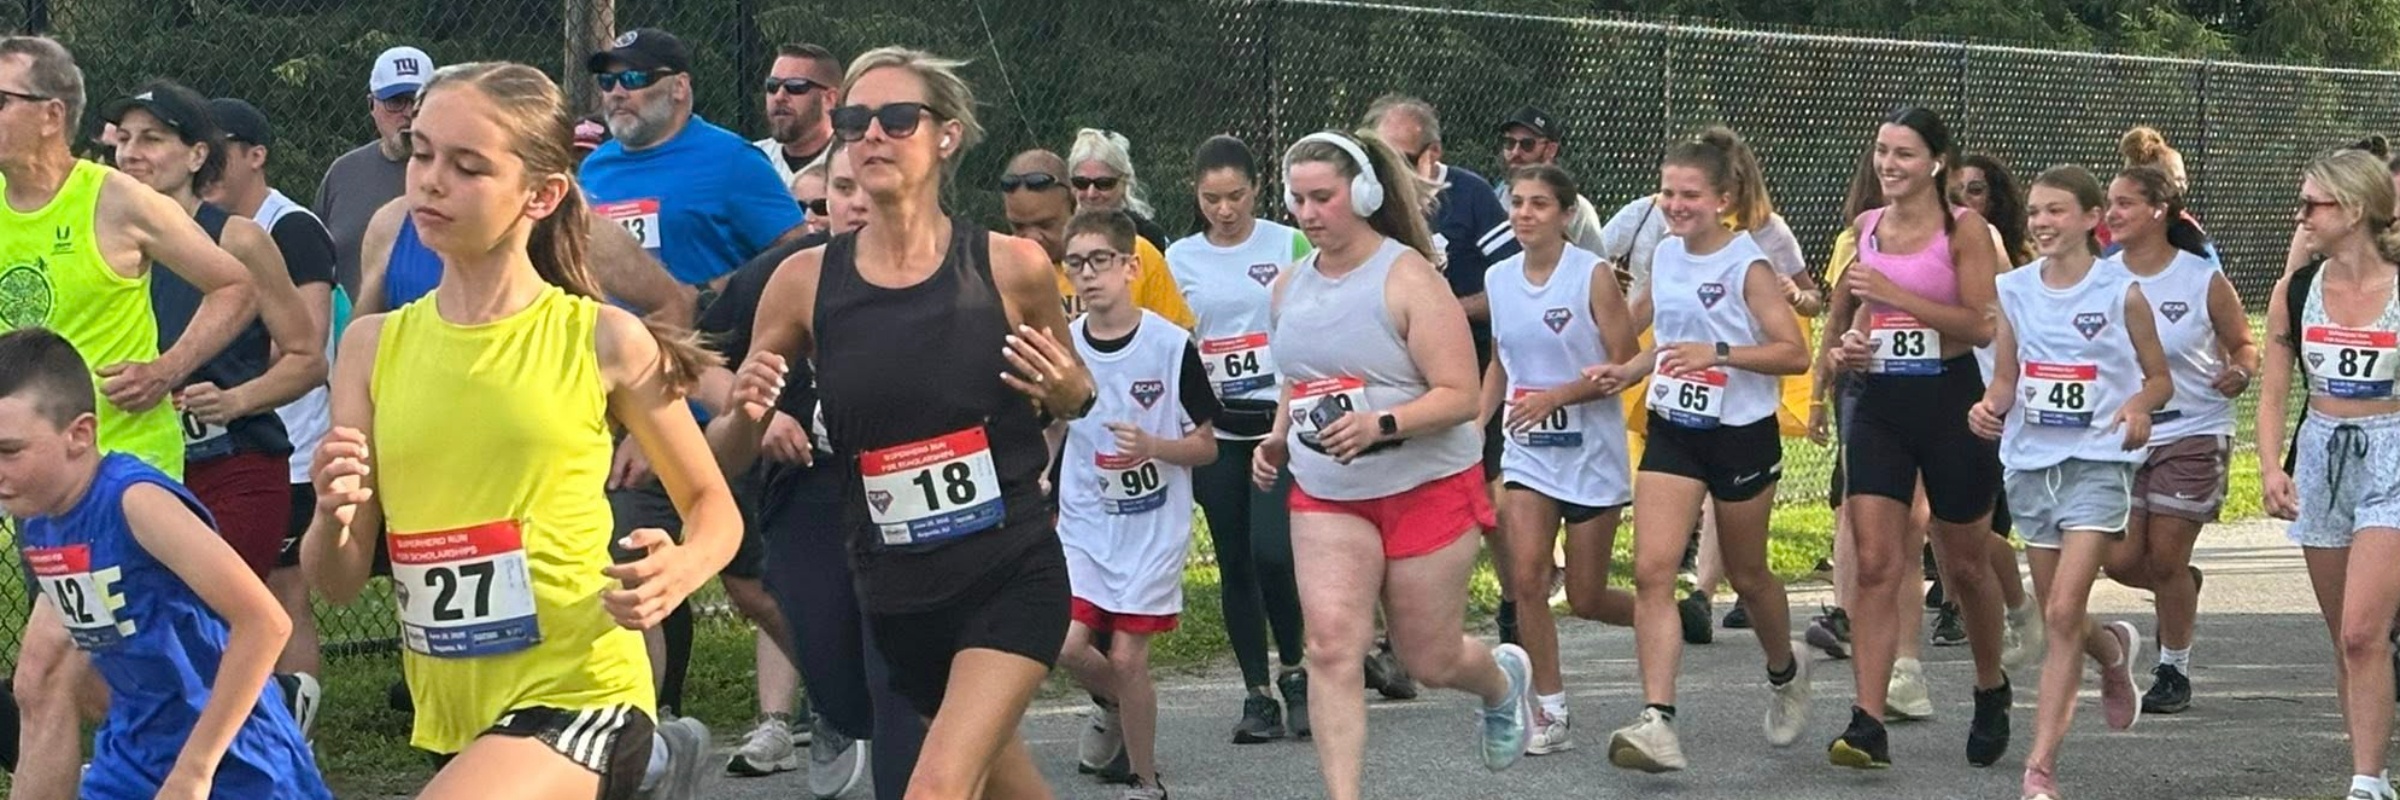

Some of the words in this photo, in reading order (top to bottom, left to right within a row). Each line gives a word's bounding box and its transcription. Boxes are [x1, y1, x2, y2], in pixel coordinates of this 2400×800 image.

[1892, 330, 1925, 357] 83
[1224, 350, 1260, 378] 64
[2338, 347, 2380, 378] 87
[1134, 382, 1162, 394] SCAR
[1678, 382, 1710, 412] 65
[2048, 382, 2085, 410] 48
[912, 461, 977, 511] 18
[1121, 461, 1159, 497] 90
[54, 578, 95, 623] 42
[424, 560, 495, 622] 27
